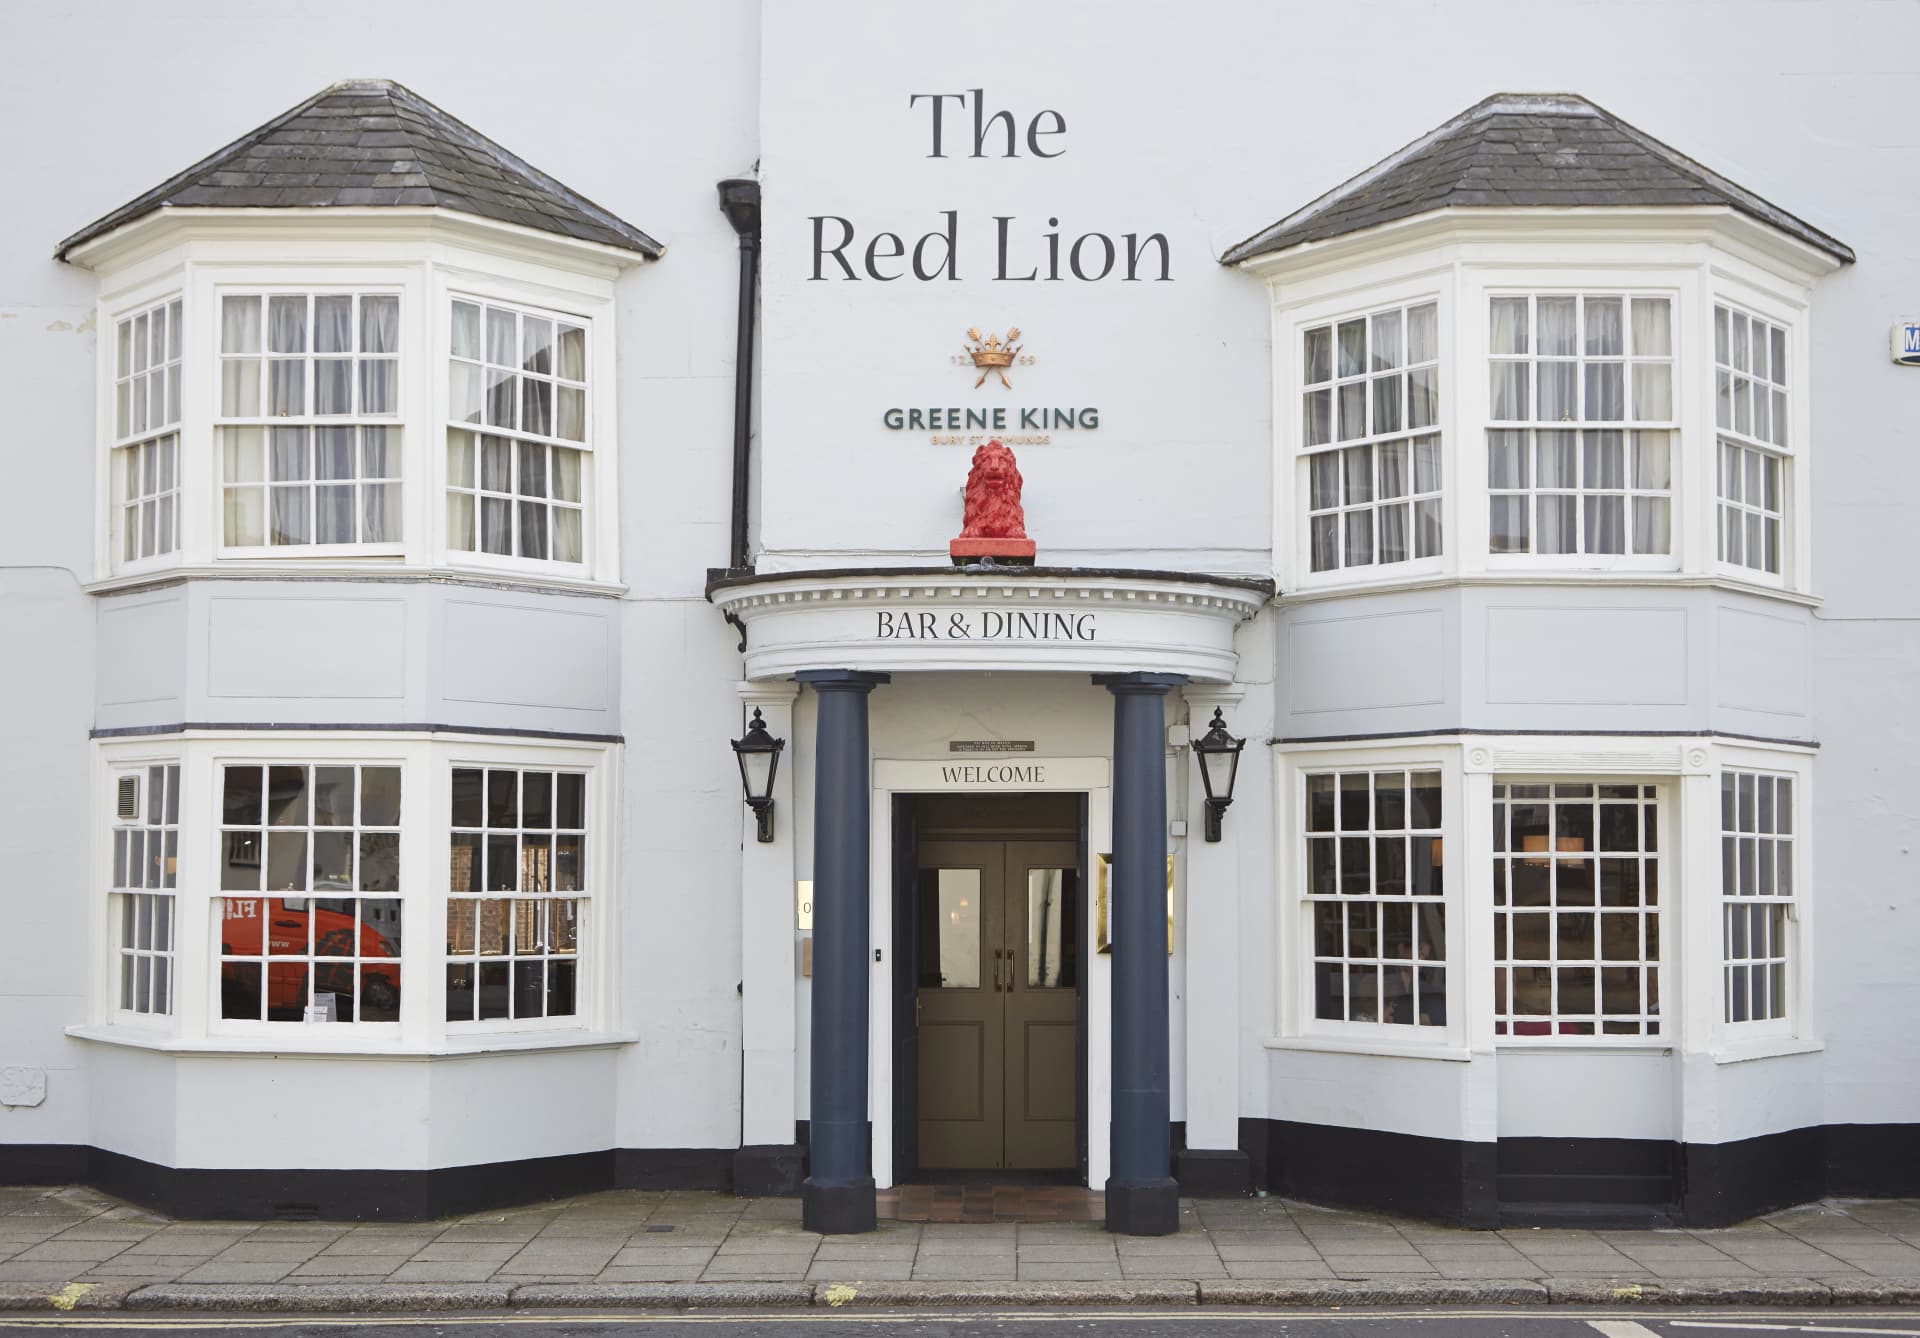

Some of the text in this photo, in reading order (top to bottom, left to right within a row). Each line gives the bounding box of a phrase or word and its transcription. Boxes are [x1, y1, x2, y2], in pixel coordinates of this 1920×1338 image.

[910, 88, 1067, 159] The
[807, 210, 1174, 282] Red Lion
[883, 407, 1099, 430] GREENE KING
[930, 434, 965, 446] BURY
[877, 611, 1096, 641] BAR & DINING
[942, 766, 1045, 783] WELCOME
